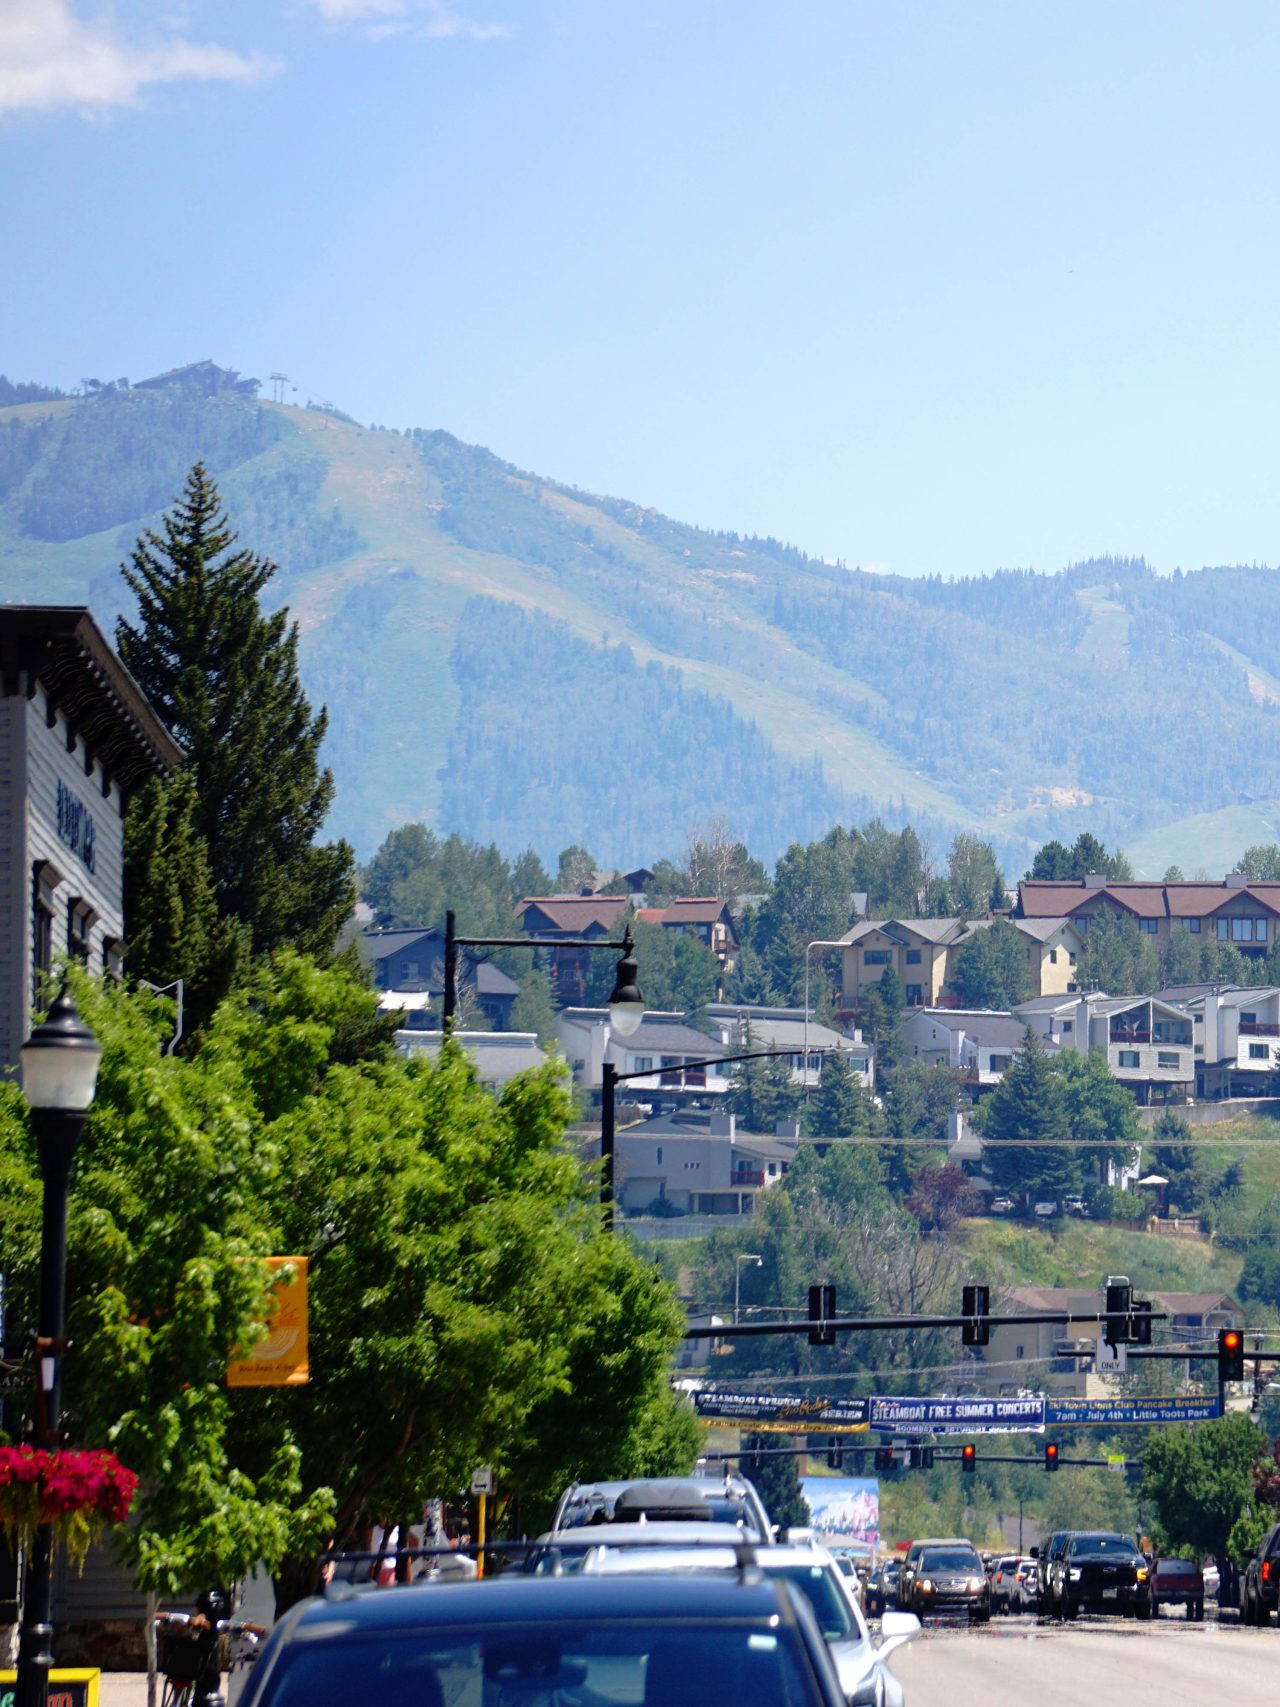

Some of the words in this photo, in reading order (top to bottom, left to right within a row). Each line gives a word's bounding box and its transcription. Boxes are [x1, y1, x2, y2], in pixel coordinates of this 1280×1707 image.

[1101, 1361, 1120, 1370] ONLY
[872, 1405, 927, 1420] STEAMBOAT
[928, 1405, 953, 1419] FREE
[955, 1403, 994, 1417] SUMMER
[997, 1401, 1042, 1416] CONCERTS
[1048, 1401, 1061, 1409] Ski
[1064, 1401, 1087, 1410] Town
[1089, 1401, 1112, 1410] Lions
[1114, 1400, 1135, 1409] Club
[1137, 1399, 1173, 1409] Pancake
[1175, 1398, 1216, 1408] Breakfast
[1055, 1411, 1077, 1420] 7am
[1086, 1410, 1105, 1421] July
[1107, 1410, 1124, 1419] 4th
[1132, 1410, 1158, 1420] Little
[1160, 1409, 1185, 1418] Toots
[1187, 1407, 1210, 1417] Park
